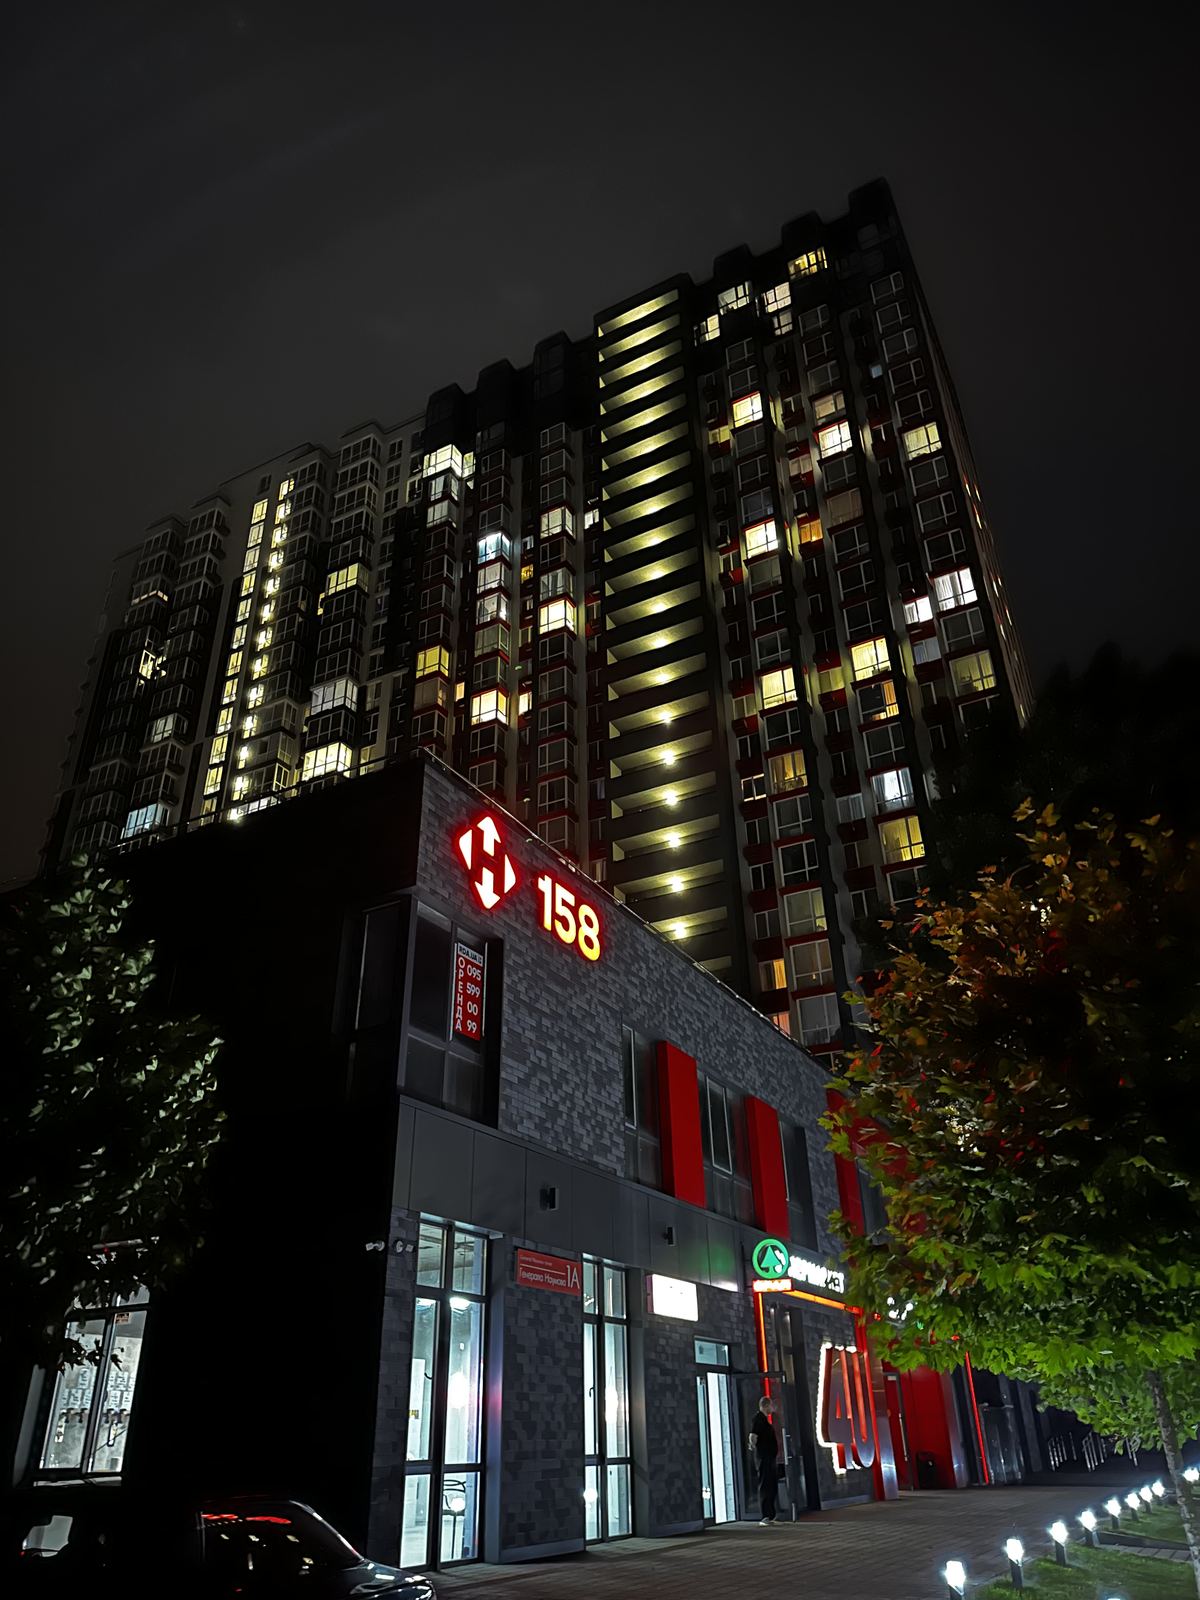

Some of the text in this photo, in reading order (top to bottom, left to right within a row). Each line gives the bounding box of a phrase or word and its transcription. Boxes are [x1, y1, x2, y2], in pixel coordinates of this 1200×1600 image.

[538, 874, 601, 961] 158
[466, 964, 482, 981] 095
[466, 982, 481, 998] 599
[467, 1001, 479, 1016] 00
[466, 1019, 478, 1034] 99
